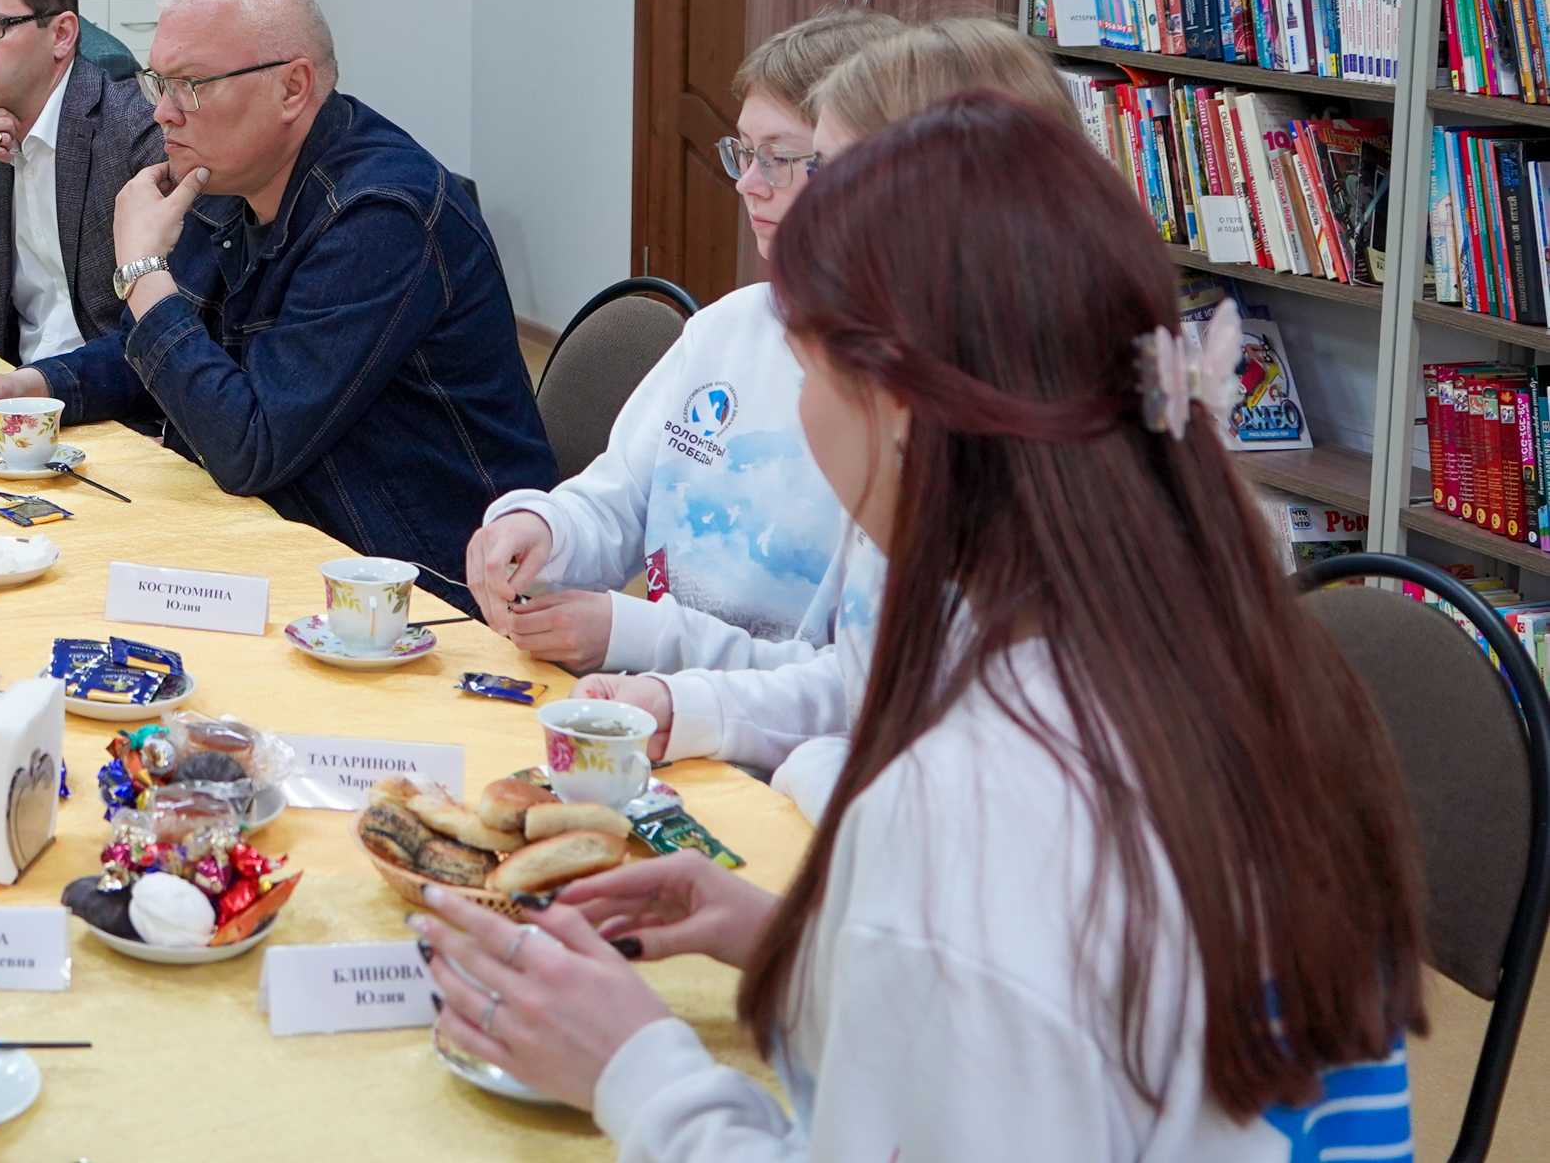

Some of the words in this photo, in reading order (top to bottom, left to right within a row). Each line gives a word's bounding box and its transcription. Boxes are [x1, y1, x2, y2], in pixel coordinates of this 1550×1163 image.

[1197, 99, 1208, 125] ПОРУ
[1220, 111, 1236, 159] БЕССМЕРТНО
[1202, 127, 1216, 174] ГРОЗНУЮ
[1230, 160, 1240, 179] ТВОЕ
[1271, 158, 1289, 204] КОМСОМОЛА
[1235, 181, 1244, 199] ИМЯ
[1283, 206, 1295, 232] ИМЕНИ
[1508, 195, 1518, 222] ДЕТЕЙ
[1512, 224, 1521, 241] ДЛЯ
[1513, 244, 1527, 312] ЭНЦИКЛОПЕДИЯ
[682, 382, 713, 424] ВСЕРОССИЙСКОЕ
[716, 409, 738, 438] ДВИЖЕНИЕ
[664, 420, 727, 457] ВОЛОНТЁРЫ
[668, 437, 714, 466] ПОБЕДЫ
[138, 581, 233, 601] КОСТРОМИНА
[165, 599, 201, 613] Юлия
[307, 753, 417, 772] ТАТАРИНОВА
[332, 964, 425, 983] БЛИНОВА
[355, 990, 406, 1006] Юлия
